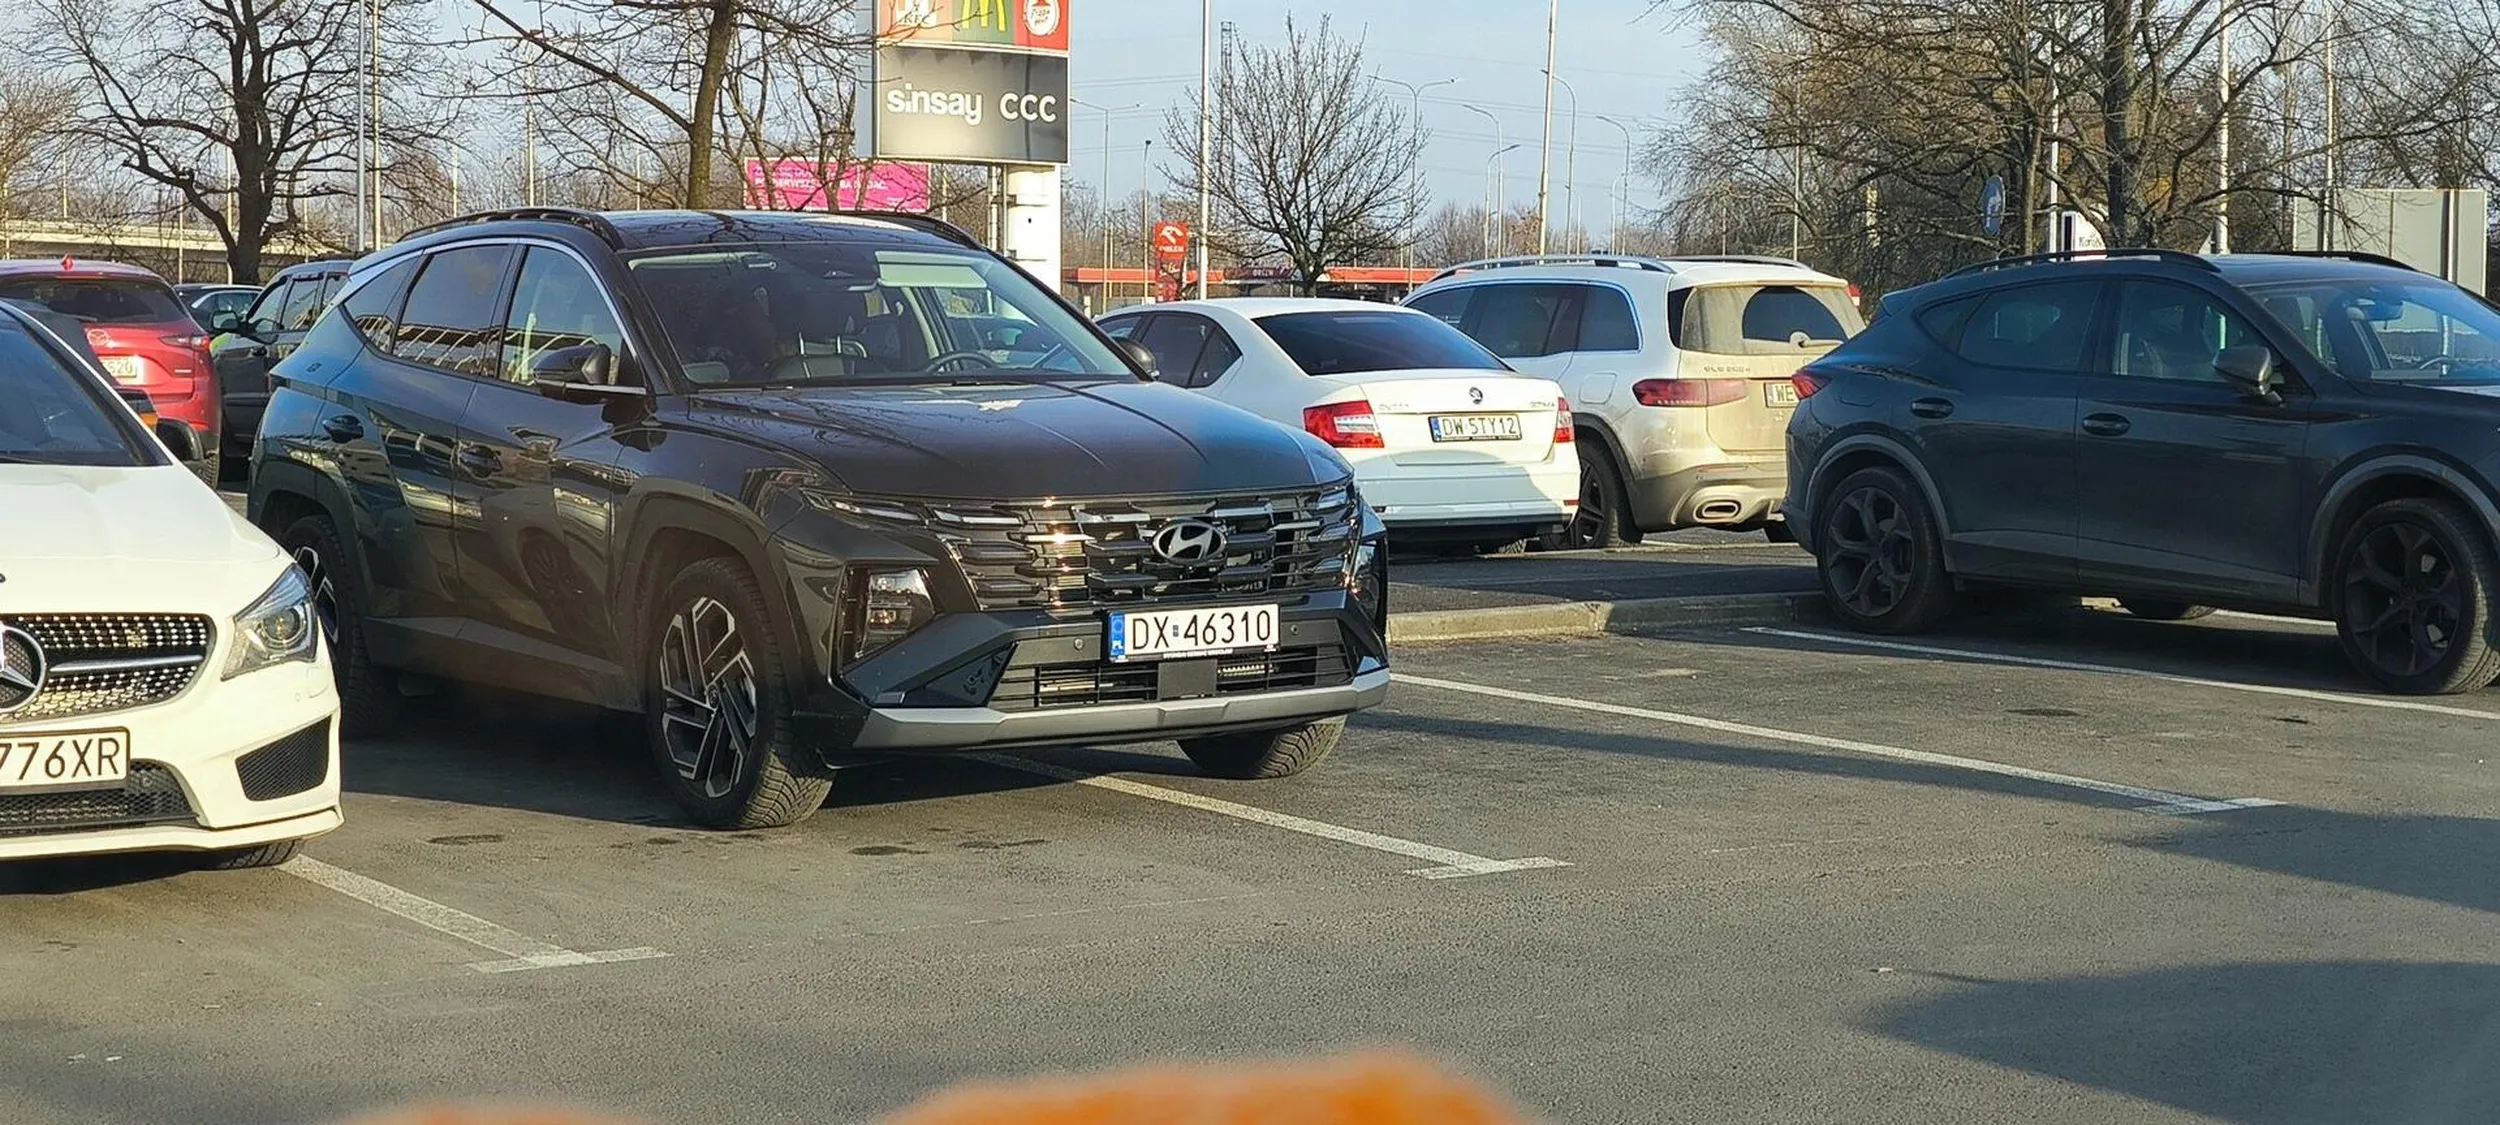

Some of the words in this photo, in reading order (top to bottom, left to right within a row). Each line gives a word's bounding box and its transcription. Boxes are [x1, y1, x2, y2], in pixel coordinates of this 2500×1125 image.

[886, 82, 983, 126] sinsay
[999, 92, 1057, 123] CCC
[1442, 417, 1465, 436] DW
[1132, 616, 1169, 650] DX
[1184, 610, 1271, 647] 46310
